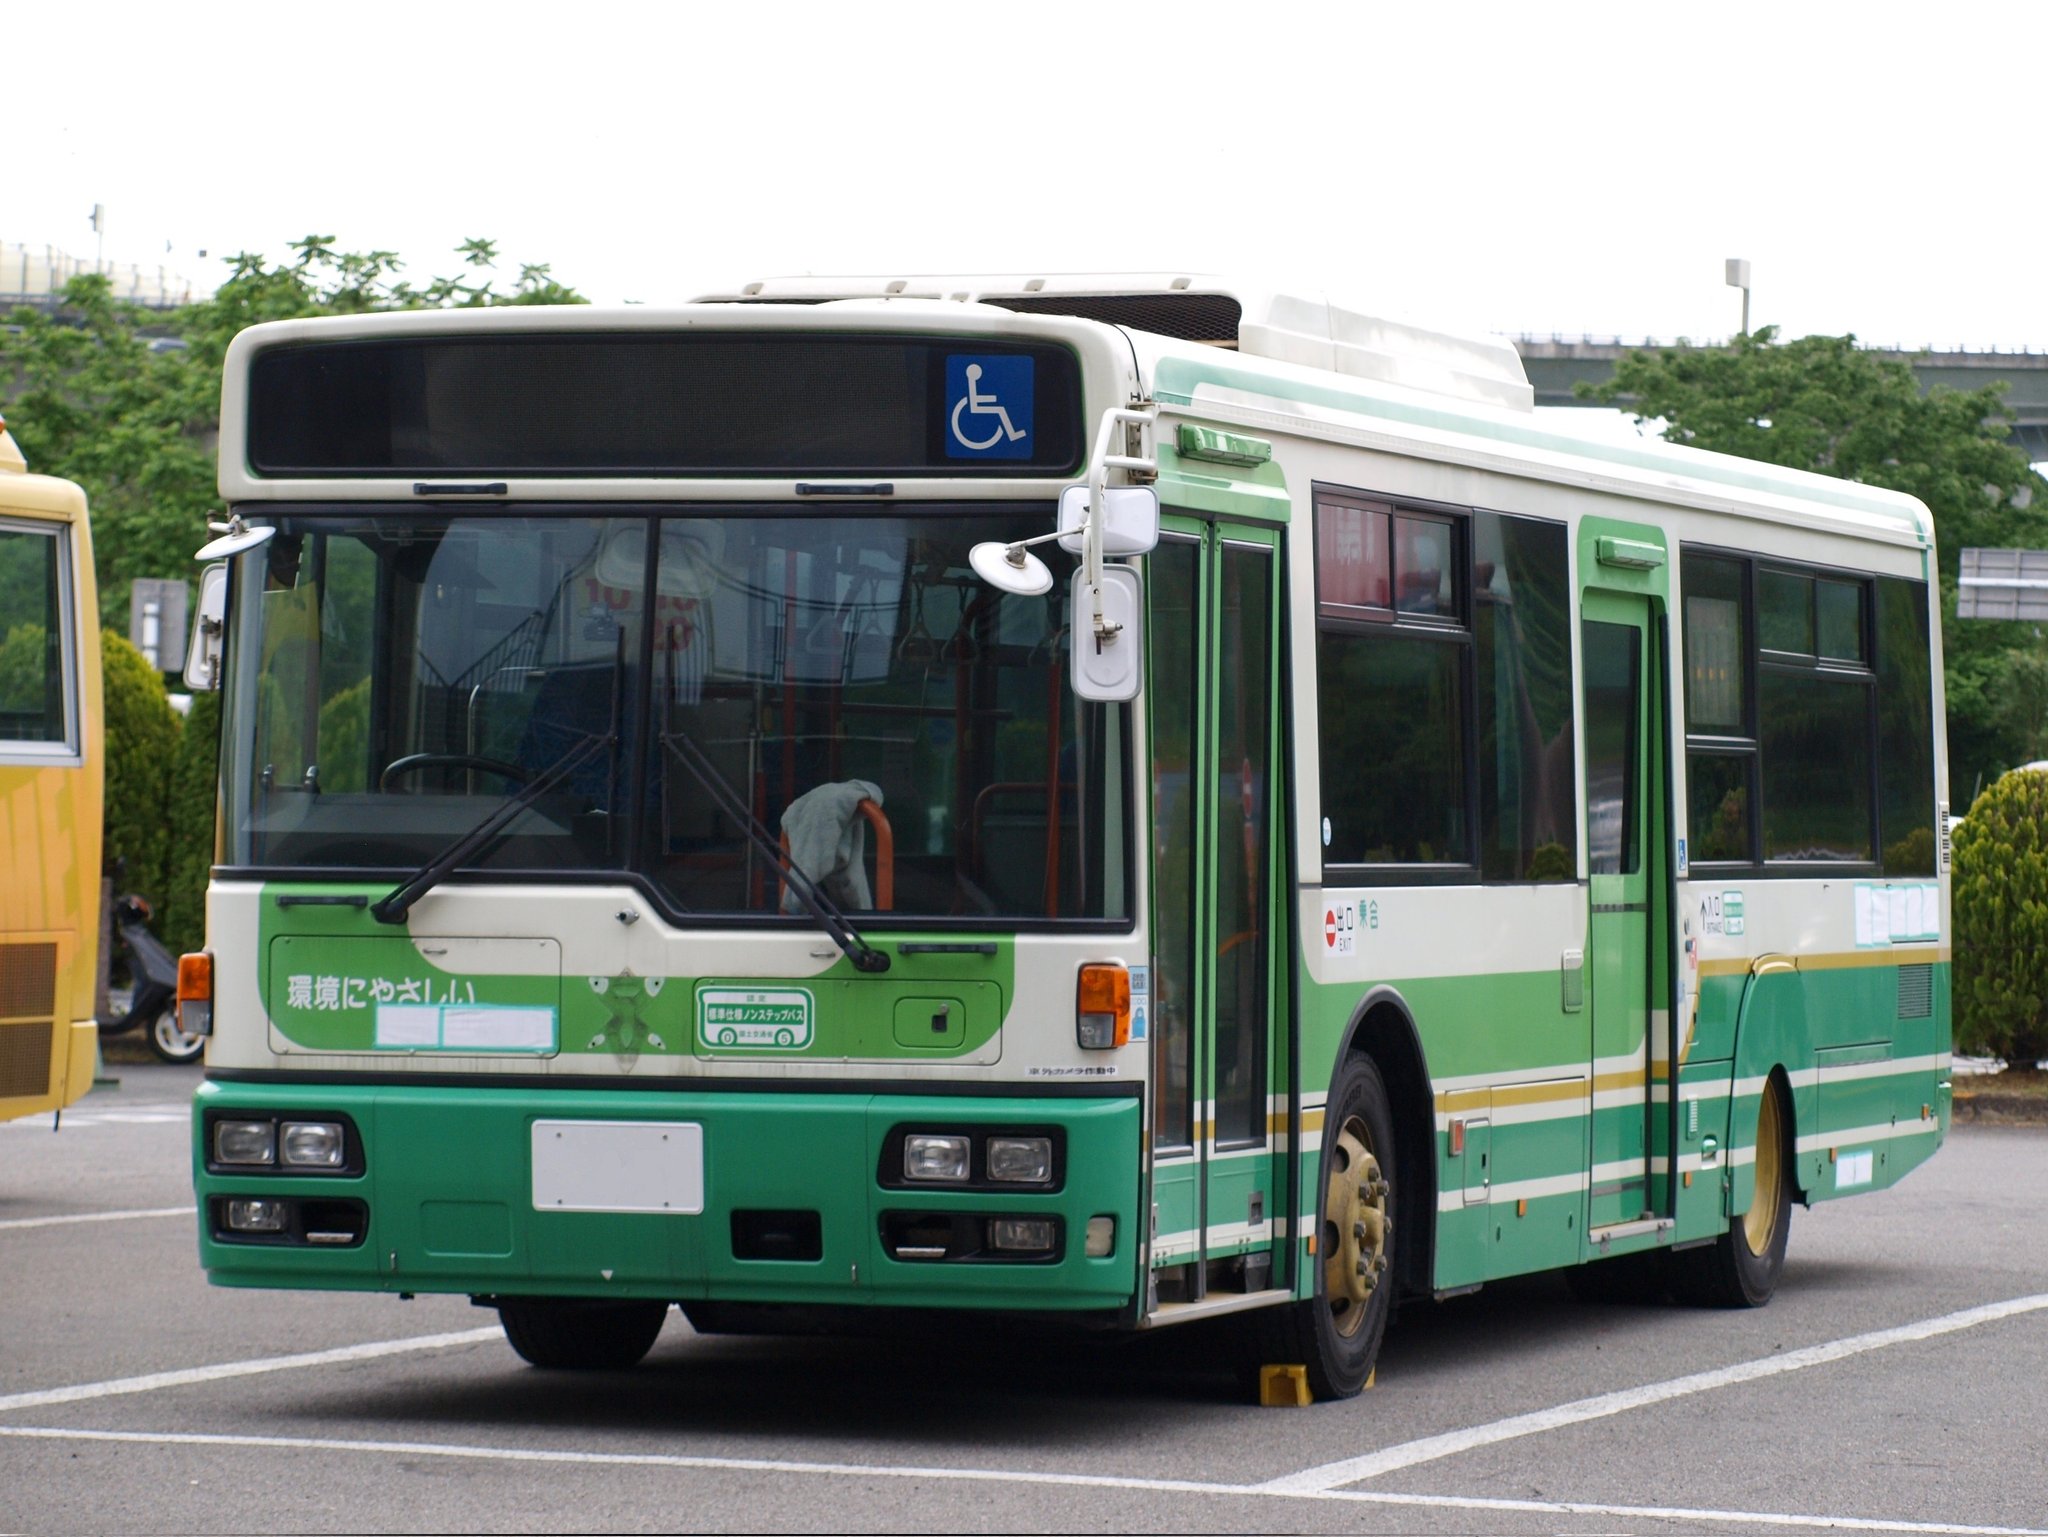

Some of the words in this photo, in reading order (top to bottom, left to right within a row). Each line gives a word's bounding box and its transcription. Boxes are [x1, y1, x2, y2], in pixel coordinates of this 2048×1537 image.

[1336, 905, 1354, 932] 出口
[1359, 897, 1379, 930] 乗合
[1338, 937, 1352, 952] EXIT
[287, 974, 476, 1011] 環境にやさしい
[708, 1007, 804, 1022] 標準仕様ノンステップバス
[1029, 1066, 1116, 1076] 車外カメラ作動中
